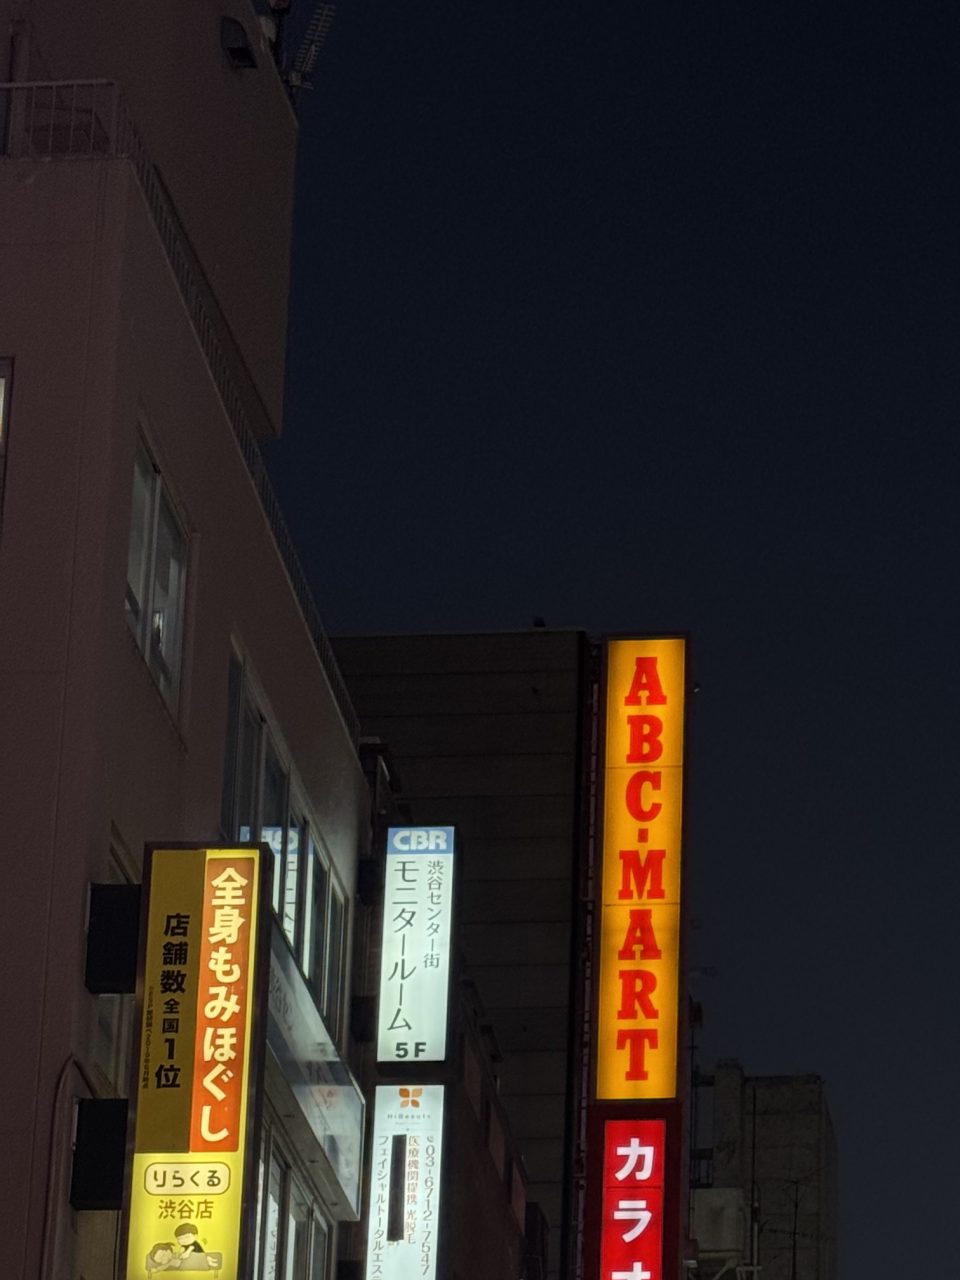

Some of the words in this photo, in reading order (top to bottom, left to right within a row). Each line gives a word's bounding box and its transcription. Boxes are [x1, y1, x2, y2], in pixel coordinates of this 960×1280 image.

[393, 829, 447, 851] CBR
[616, 657, 667, 1081] ABC-MART
[387, 860, 419, 1031] モニタールーム
[423, 860, 443, 969] 渋谷センター街
[200, 867, 248, 1143] 全身もみほぐし
[396, 1042, 426, 1058] 5F
[152, 1168, 222, 1188] りらくる
[158, 1199, 213, 1220] 渋谷店
